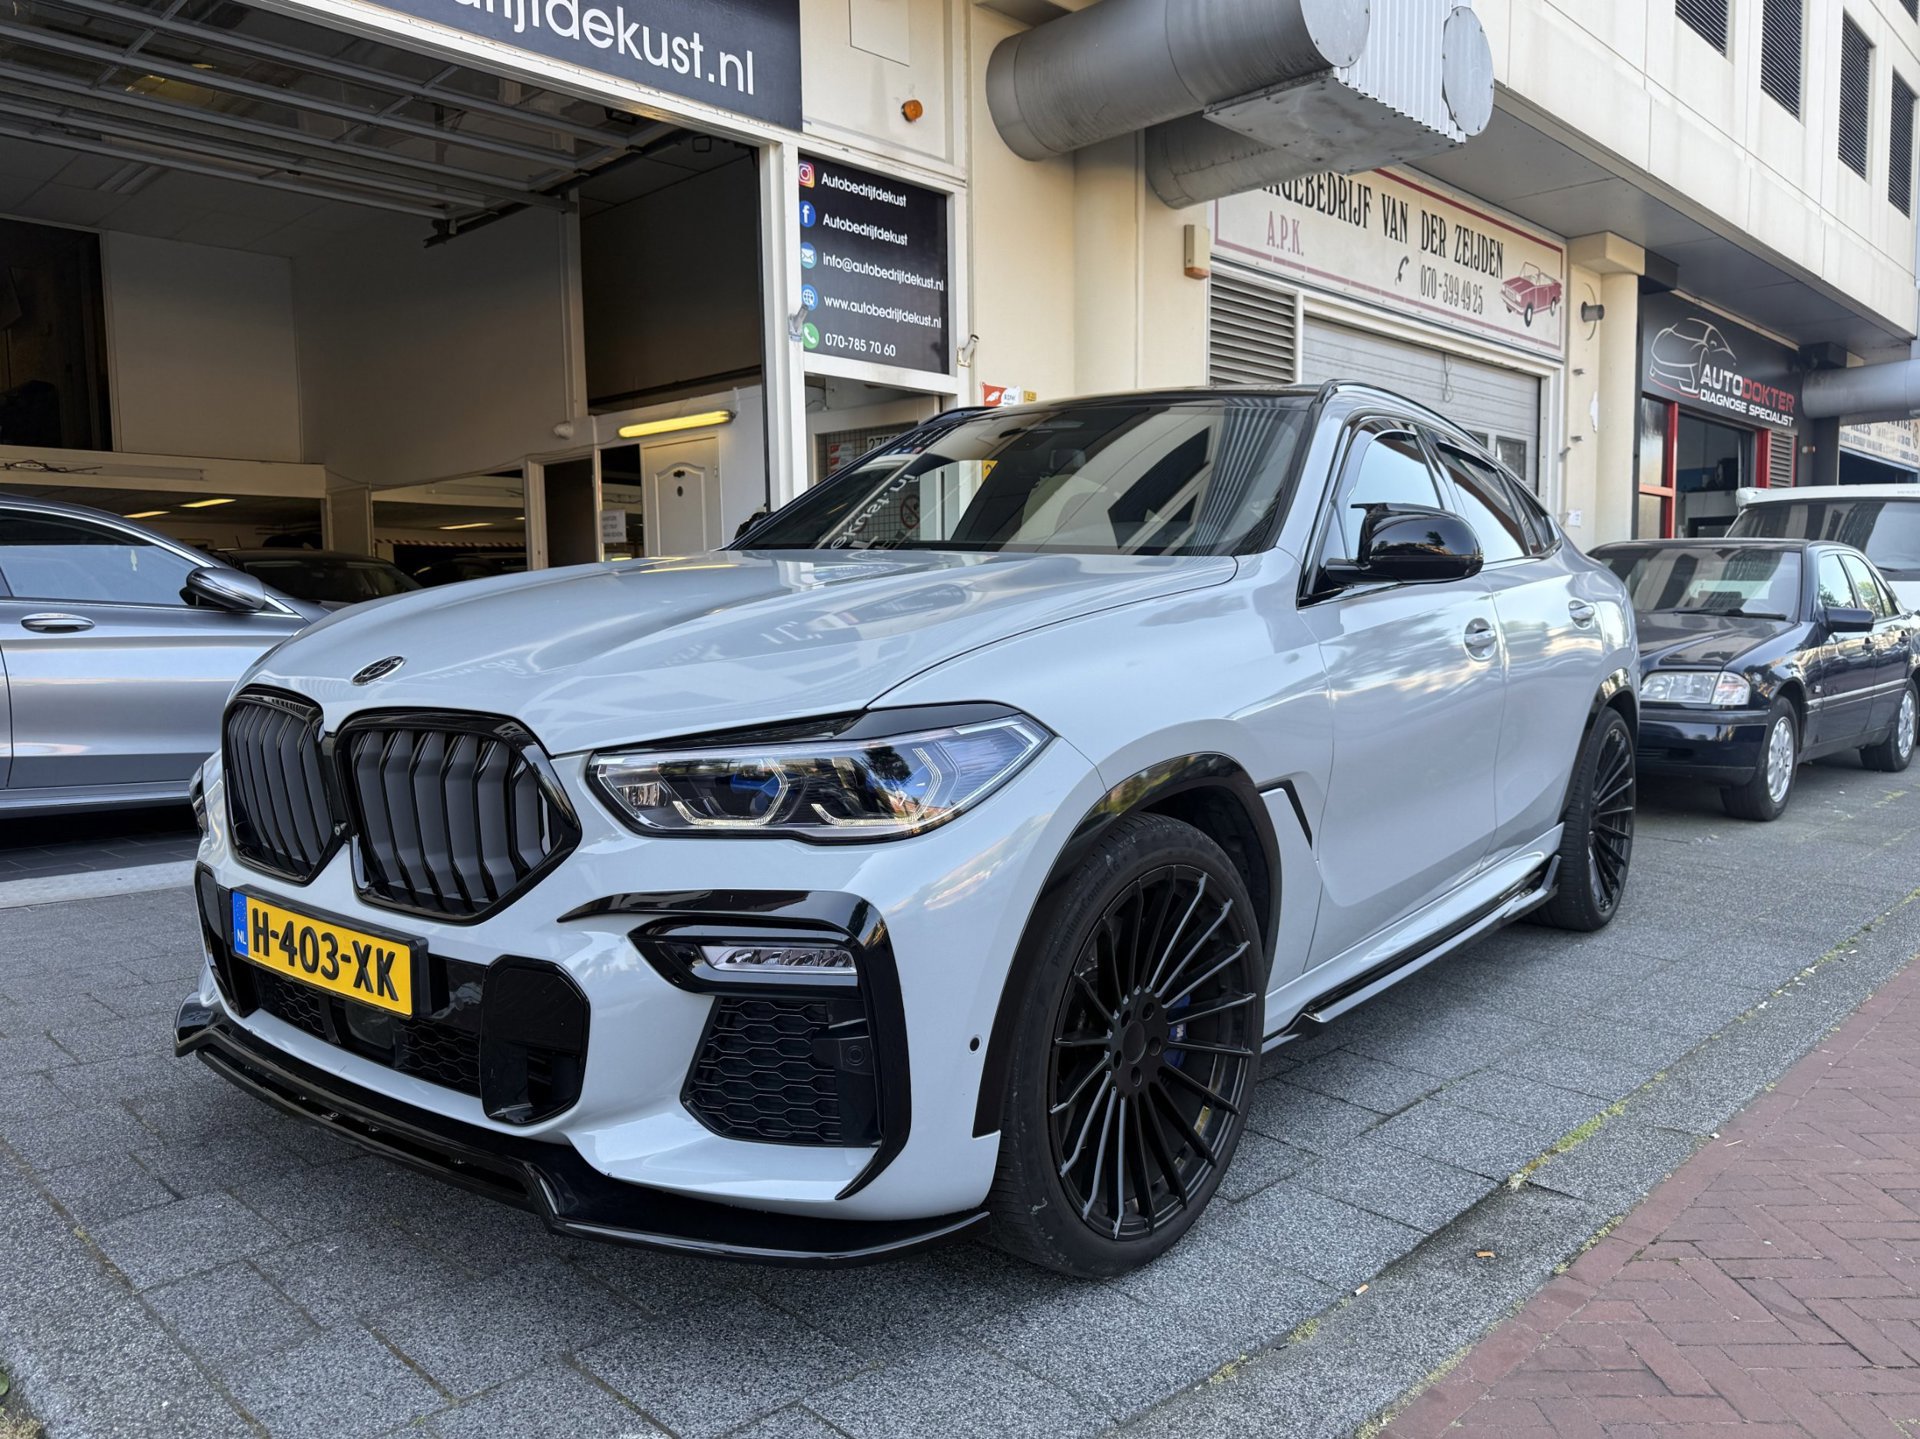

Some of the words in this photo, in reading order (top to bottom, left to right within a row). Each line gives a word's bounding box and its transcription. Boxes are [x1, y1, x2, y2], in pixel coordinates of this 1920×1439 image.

[821, 172, 907, 207] Autobedrijfdekust
[822, 213, 908, 246] Autobedrijfdekust
[1263, 172, 1372, 229] EBEDRIJF
[1381, 193, 1409, 243] VAN
[1421, 210, 1447, 258] DER
[1454, 224, 1504, 279] ZEIJDEN
[1266, 210, 1305, 257] A.P.K.
[822, 252, 944, 292] info@autobedrijfdekust.nl
[823, 294, 942, 329] www.autobedrijfdekust.nl
[1460, 280, 1471, 311] 49
[1472, 284, 1483, 315] 25
[824, 332, 867, 353] 070-785
[868, 339, 883, 355] 70
[883, 342, 897, 358] 60
[1700, 389, 1747, 414] DIAGNOSE
[1748, 404, 1794, 428] SPECIALIST
[869, 435, 896, 450] 27
[236, 928, 247, 945] NL
[252, 908, 399, 1002] H-403-XK
